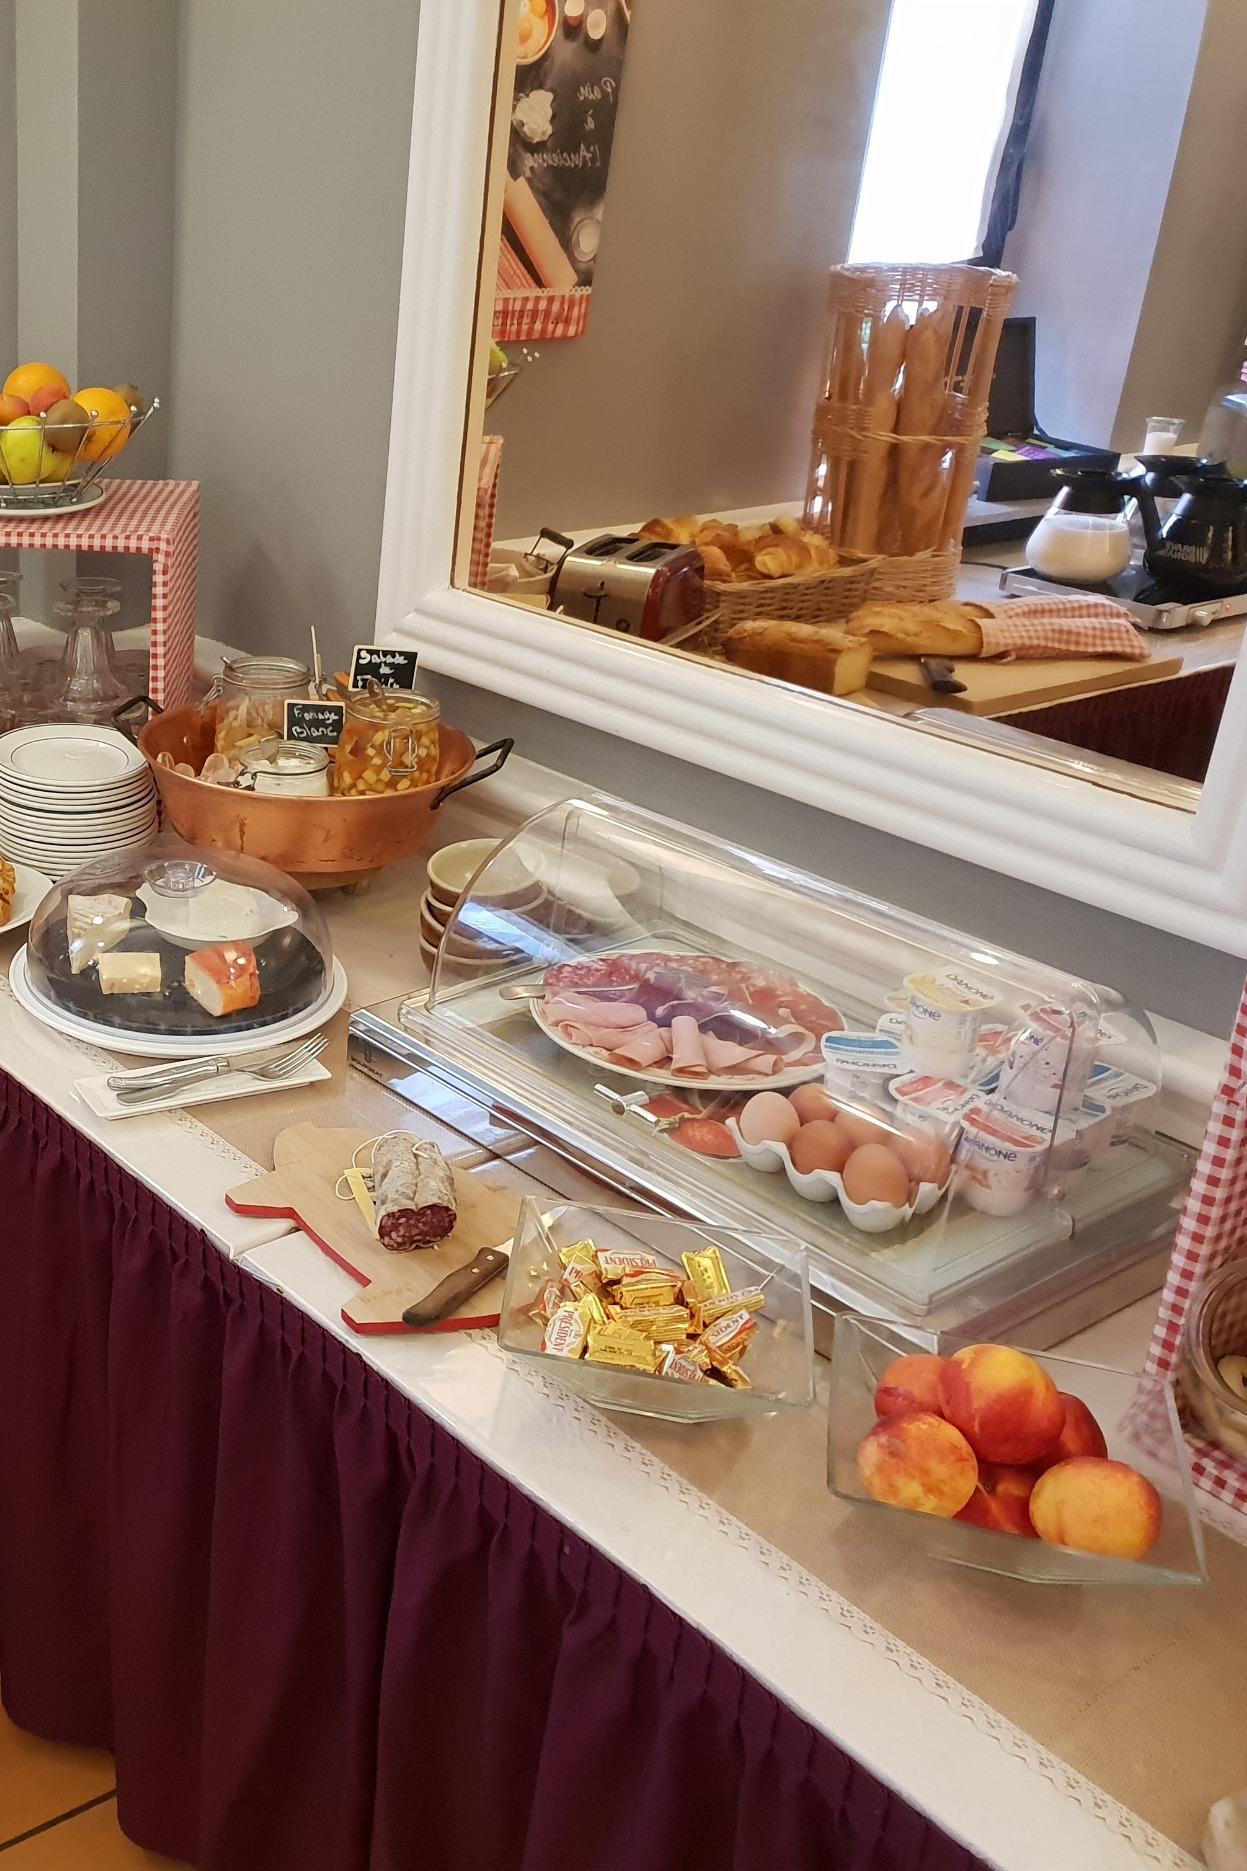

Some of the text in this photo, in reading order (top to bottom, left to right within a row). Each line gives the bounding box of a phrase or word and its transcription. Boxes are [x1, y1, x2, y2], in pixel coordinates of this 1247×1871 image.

[359, 650, 408, 665] Salade
[292, 724, 337, 737] Blanc
[710, 1314, 745, 1339] SIDENT
